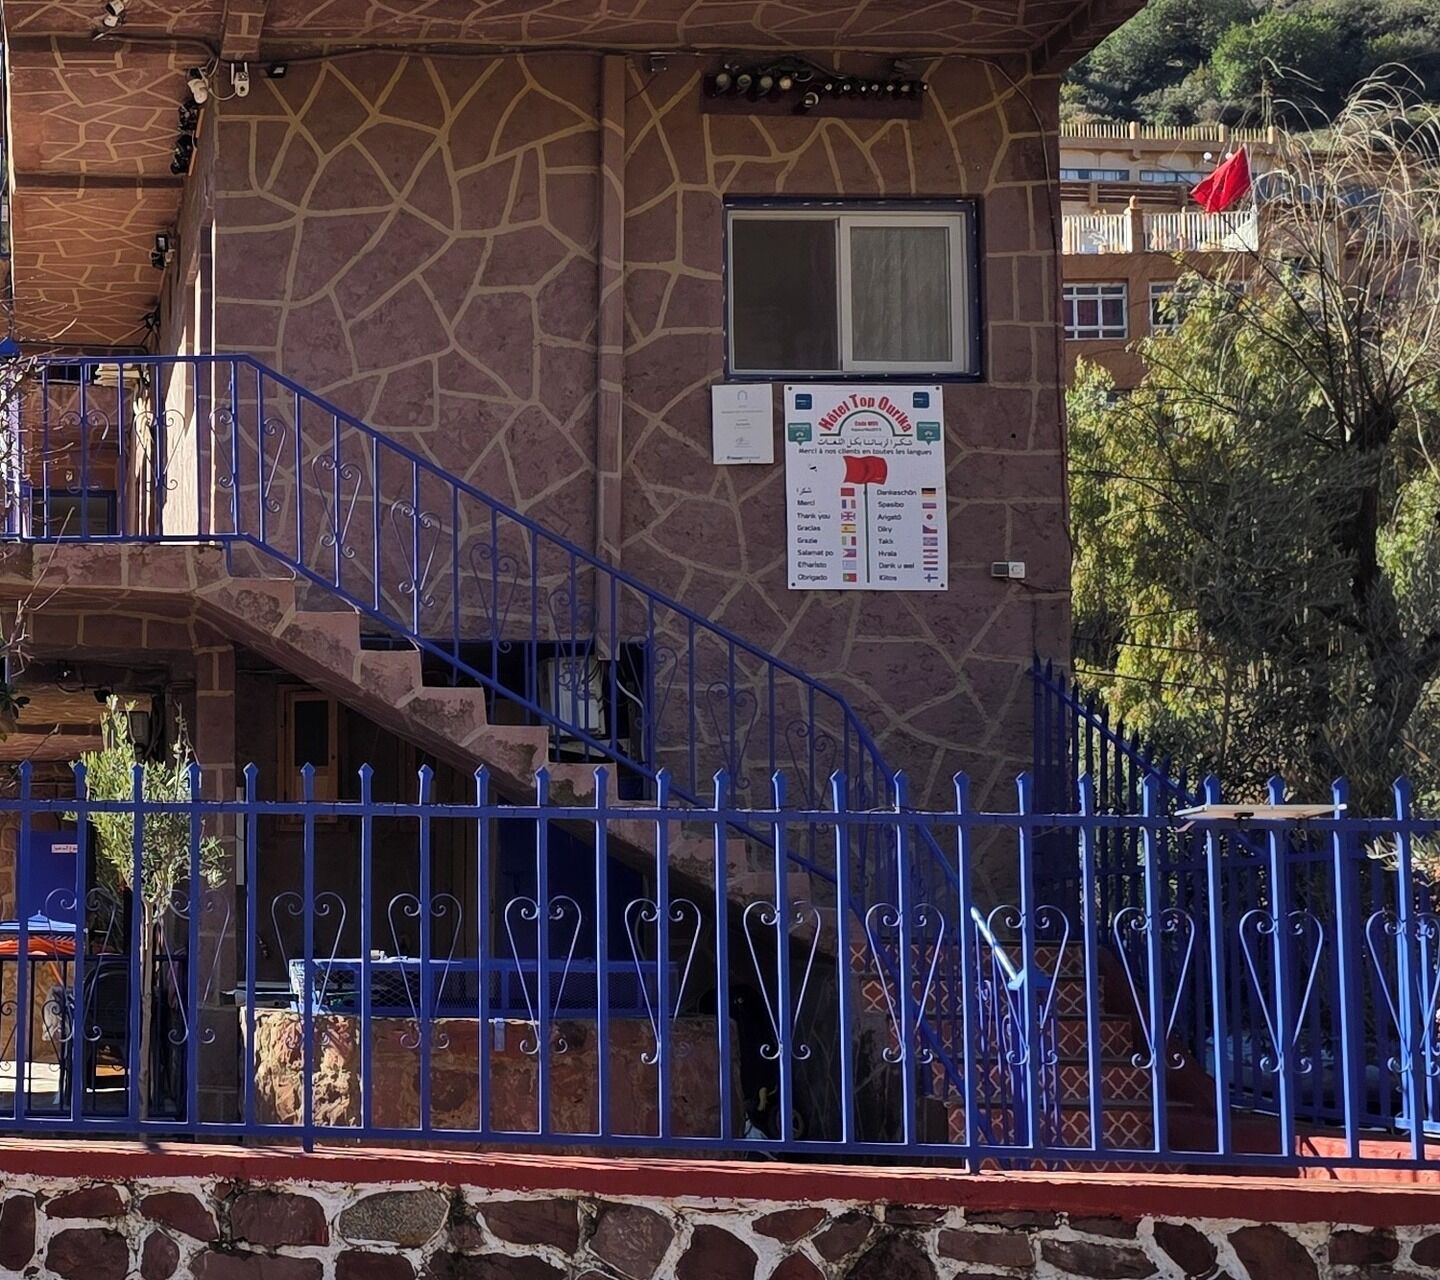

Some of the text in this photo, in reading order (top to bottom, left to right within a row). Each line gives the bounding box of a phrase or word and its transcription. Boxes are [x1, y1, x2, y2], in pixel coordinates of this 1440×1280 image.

[818, 393, 912, 433] Hôtel Top Ourika
[907, 448, 932, 456] langues
[798, 573, 828, 581] Obrigado
